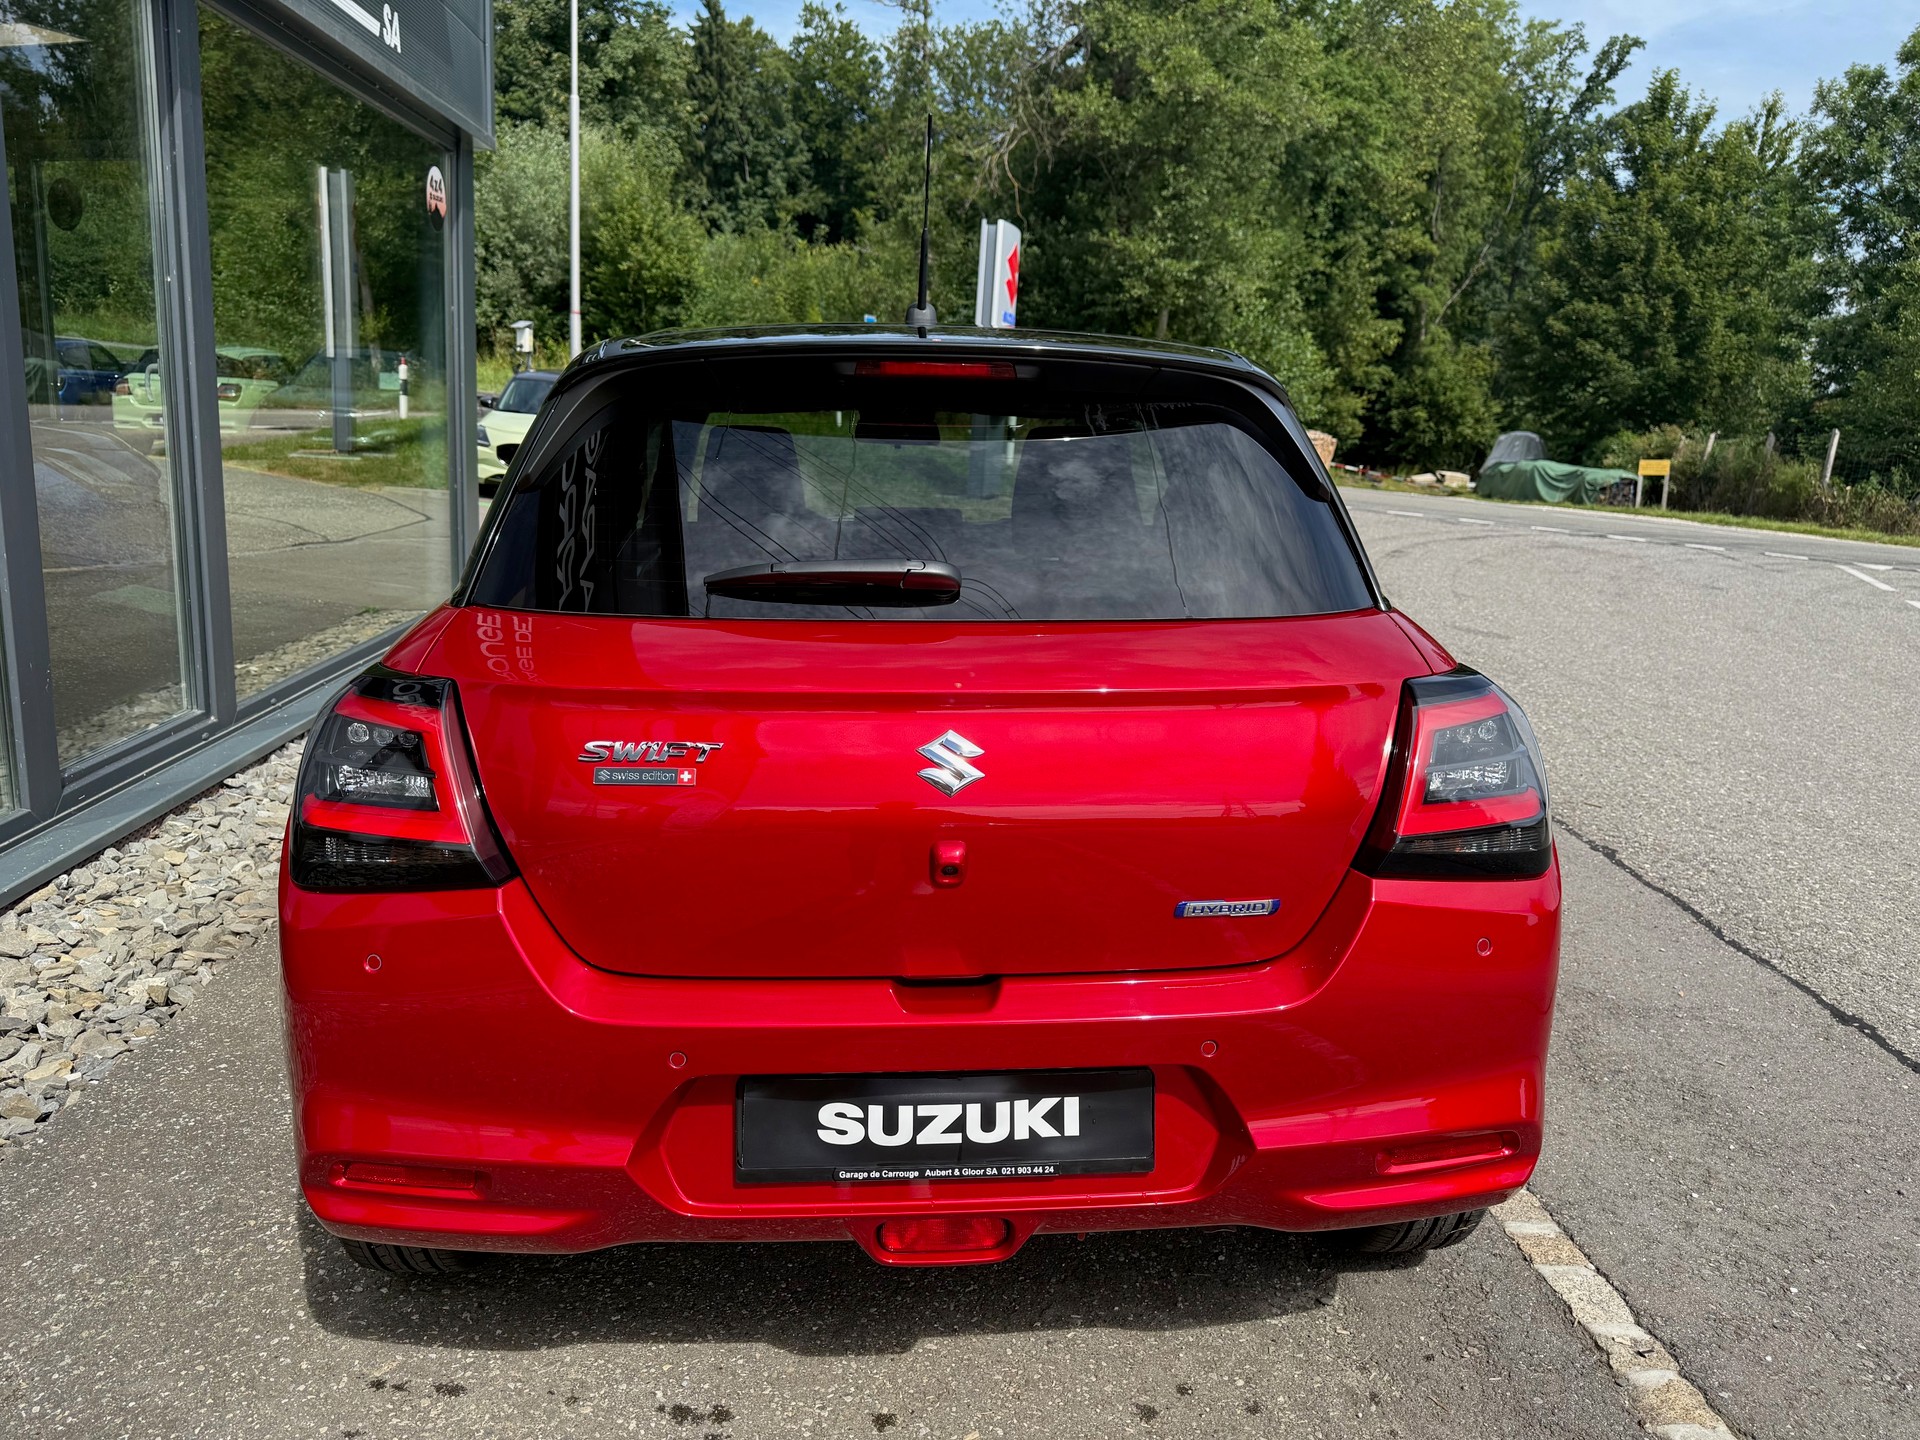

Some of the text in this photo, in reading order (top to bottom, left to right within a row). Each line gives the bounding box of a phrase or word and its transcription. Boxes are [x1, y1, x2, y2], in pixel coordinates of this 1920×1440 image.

[382, 3, 401, 53] SA
[578, 740, 724, 763] SWIFT
[611, 769, 675, 781] swiss edition
[1191, 902, 1266, 914] HYBRID
[817, 1096, 1080, 1147] SUZUKI
[839, 1166, 1054, 1180] Garage de Carrouge Aubert & Gloor SA 021 903 44 24
